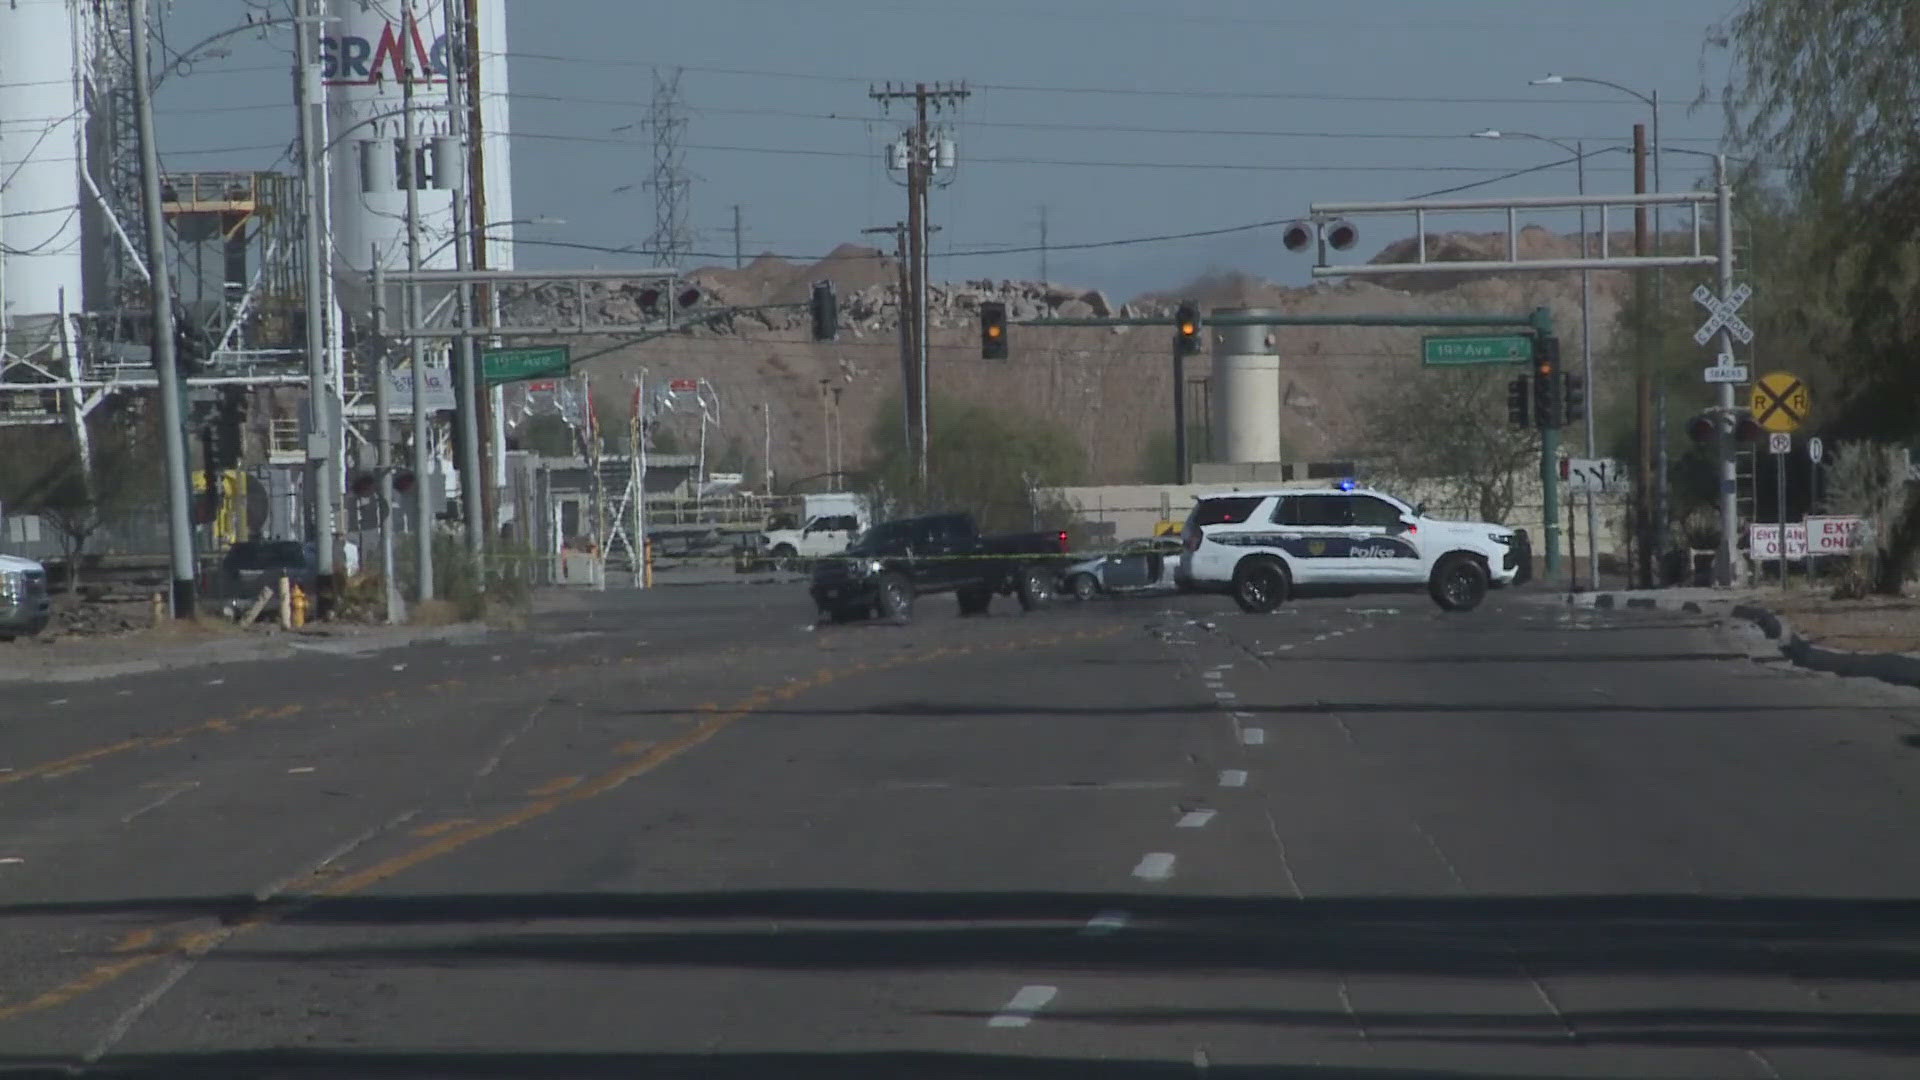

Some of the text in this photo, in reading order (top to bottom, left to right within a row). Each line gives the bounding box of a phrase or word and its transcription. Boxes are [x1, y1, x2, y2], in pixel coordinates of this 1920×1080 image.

[1696, 288, 1751, 342] RAILROAD
[1698, 287, 1750, 342] CROSSING
[1464, 344, 1491, 356] Ave
[1722, 355, 1729, 364] 2
[1755, 395, 1805, 410] R R
[1351, 545, 1396, 558] Police
[1767, 542, 1807, 554] OLY
